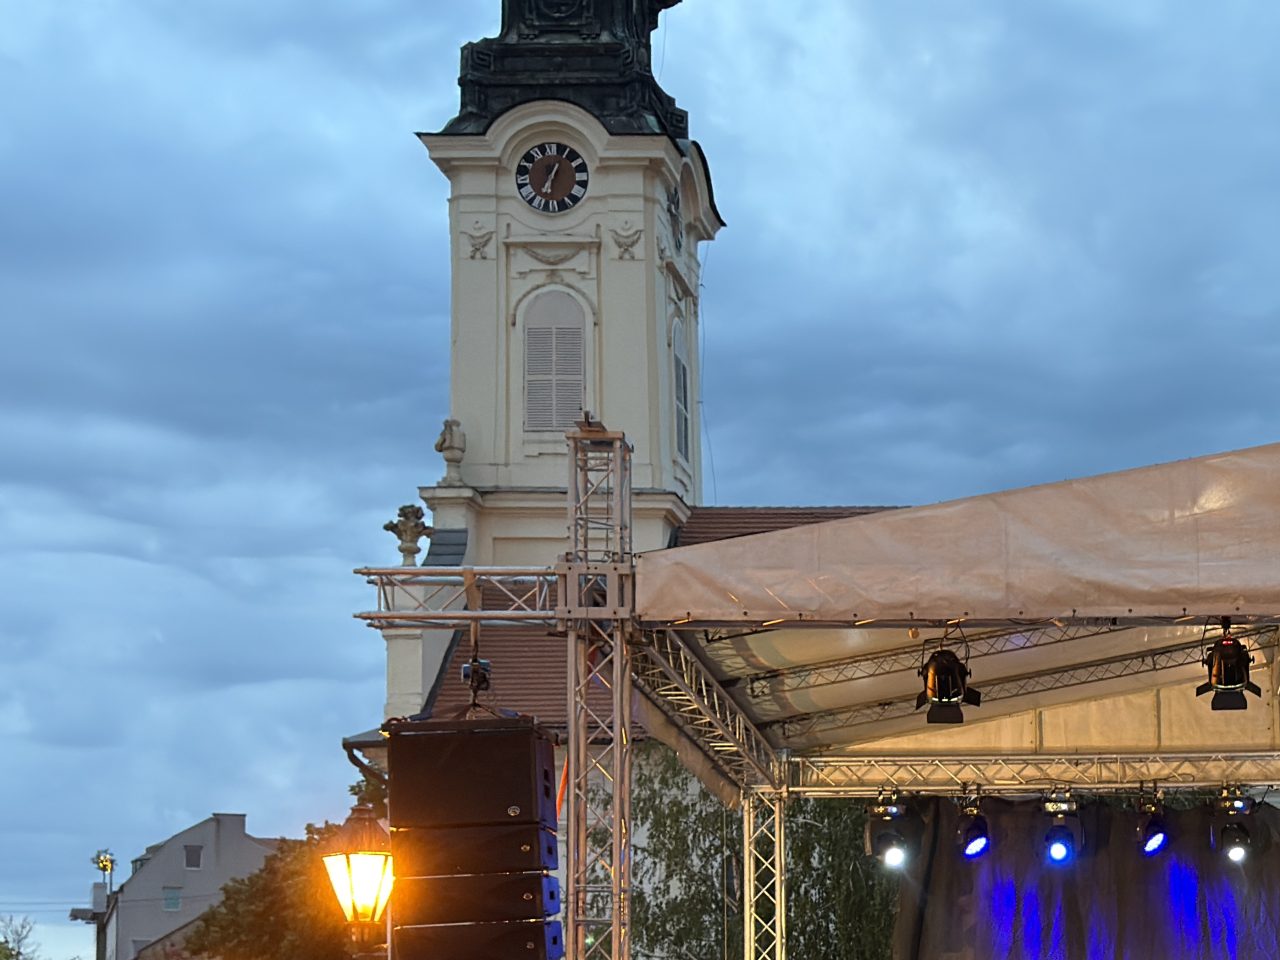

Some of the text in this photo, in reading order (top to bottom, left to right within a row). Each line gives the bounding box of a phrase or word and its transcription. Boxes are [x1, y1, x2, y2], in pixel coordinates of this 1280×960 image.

[530, 147, 543, 161] XI
[545, 144, 557, 156] XII
[562, 147, 570, 158] I
